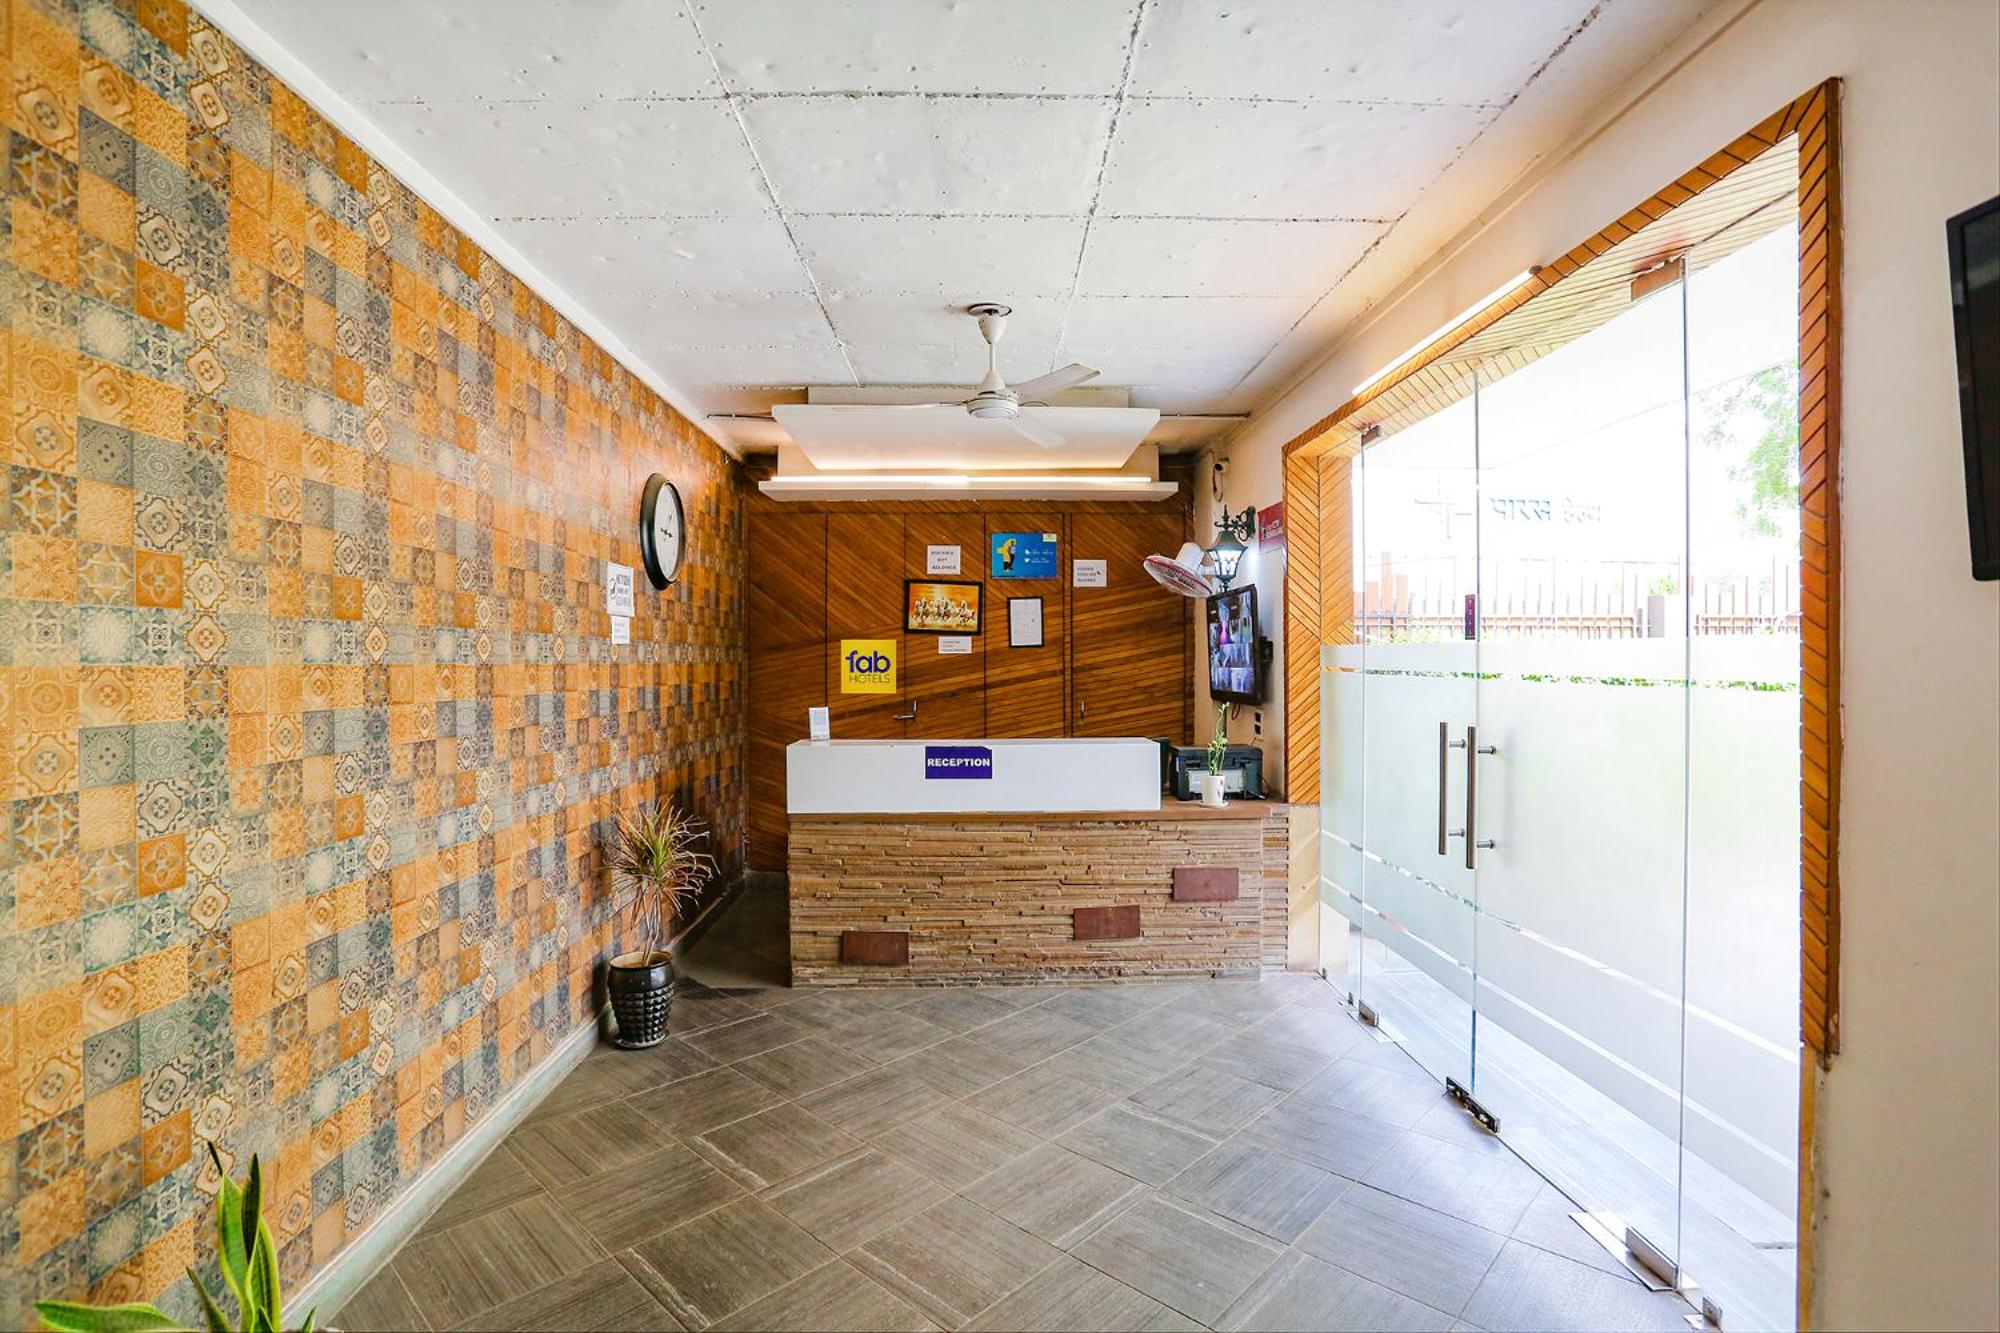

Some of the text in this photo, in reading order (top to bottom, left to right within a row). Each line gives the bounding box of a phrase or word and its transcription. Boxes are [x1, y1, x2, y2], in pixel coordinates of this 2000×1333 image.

[845, 650, 891, 674] fab
[848, 673, 891, 683] HOTELS
[927, 757, 991, 768] RECEPTION
